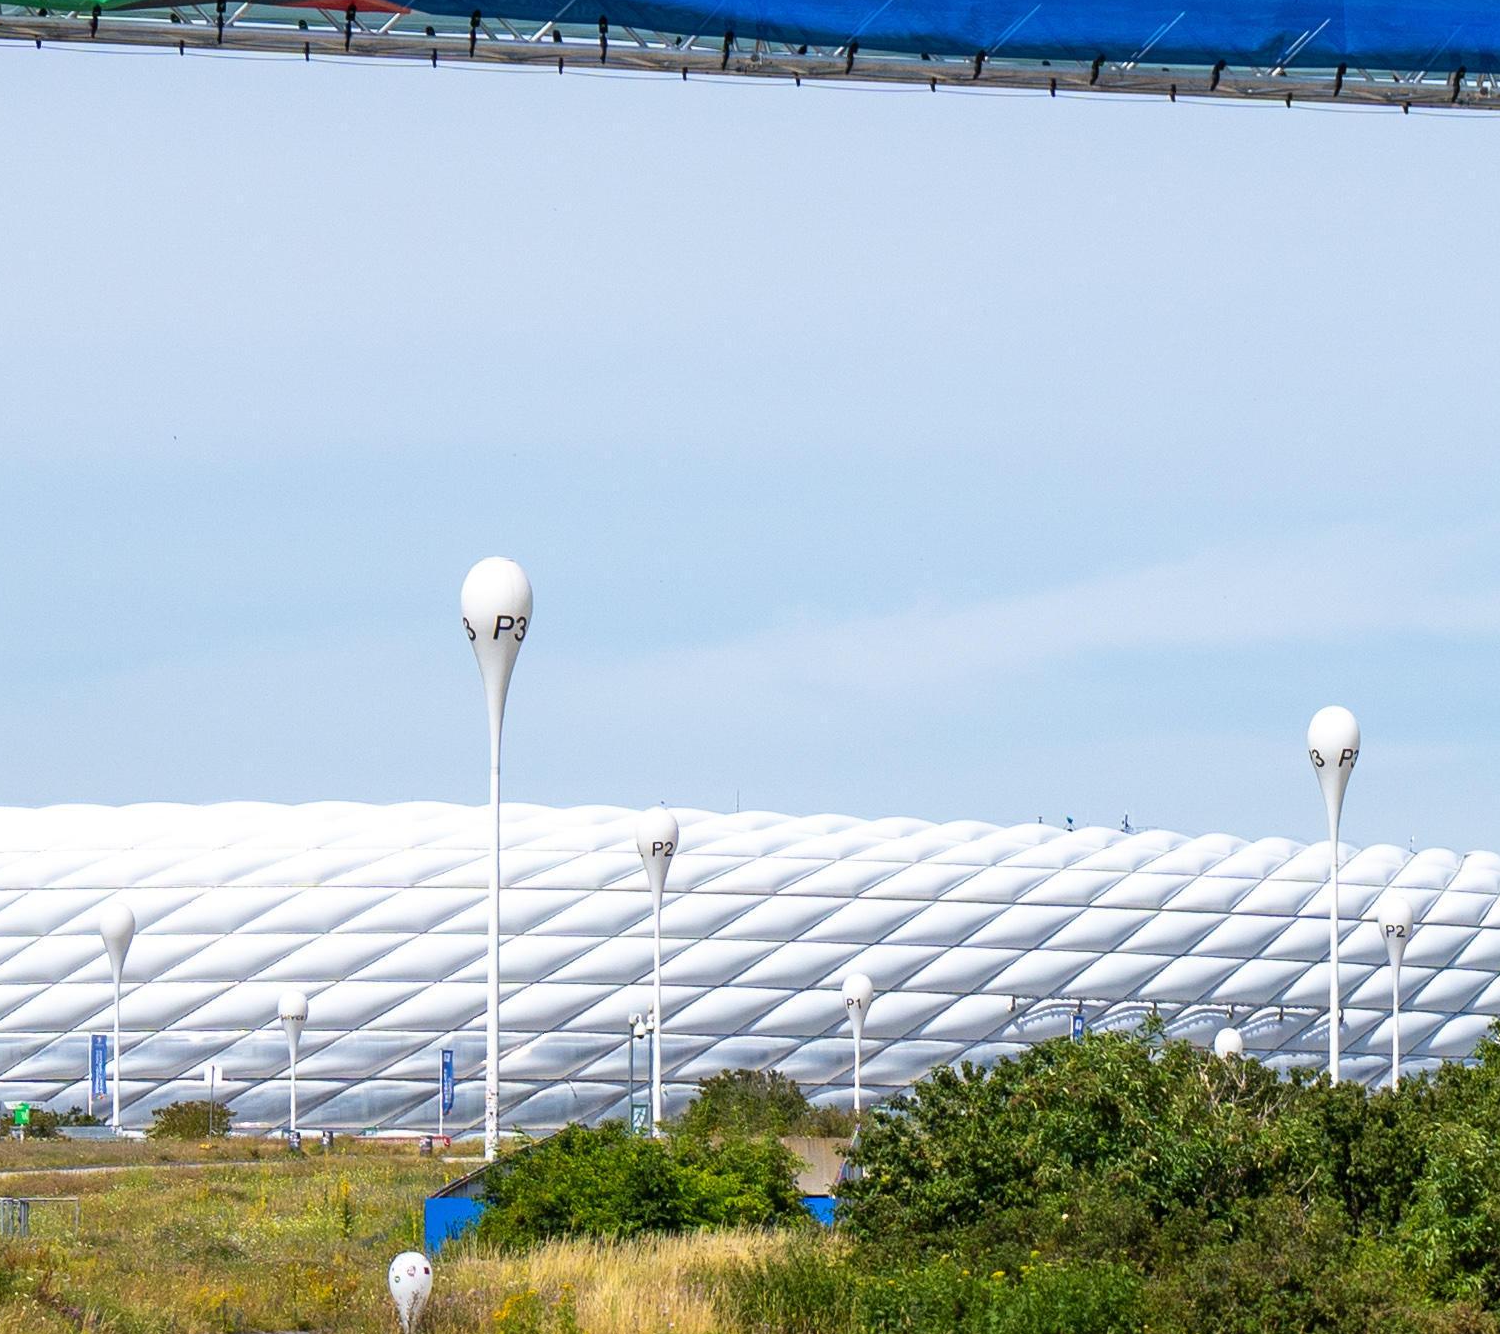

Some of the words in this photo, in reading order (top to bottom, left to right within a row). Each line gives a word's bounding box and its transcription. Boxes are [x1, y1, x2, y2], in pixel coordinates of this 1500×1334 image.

[493, 615, 527, 642] P3
[652, 841, 674, 857] P2
[1385, 924, 1405, 938] P2
[846, 998, 861, 1010] P1
